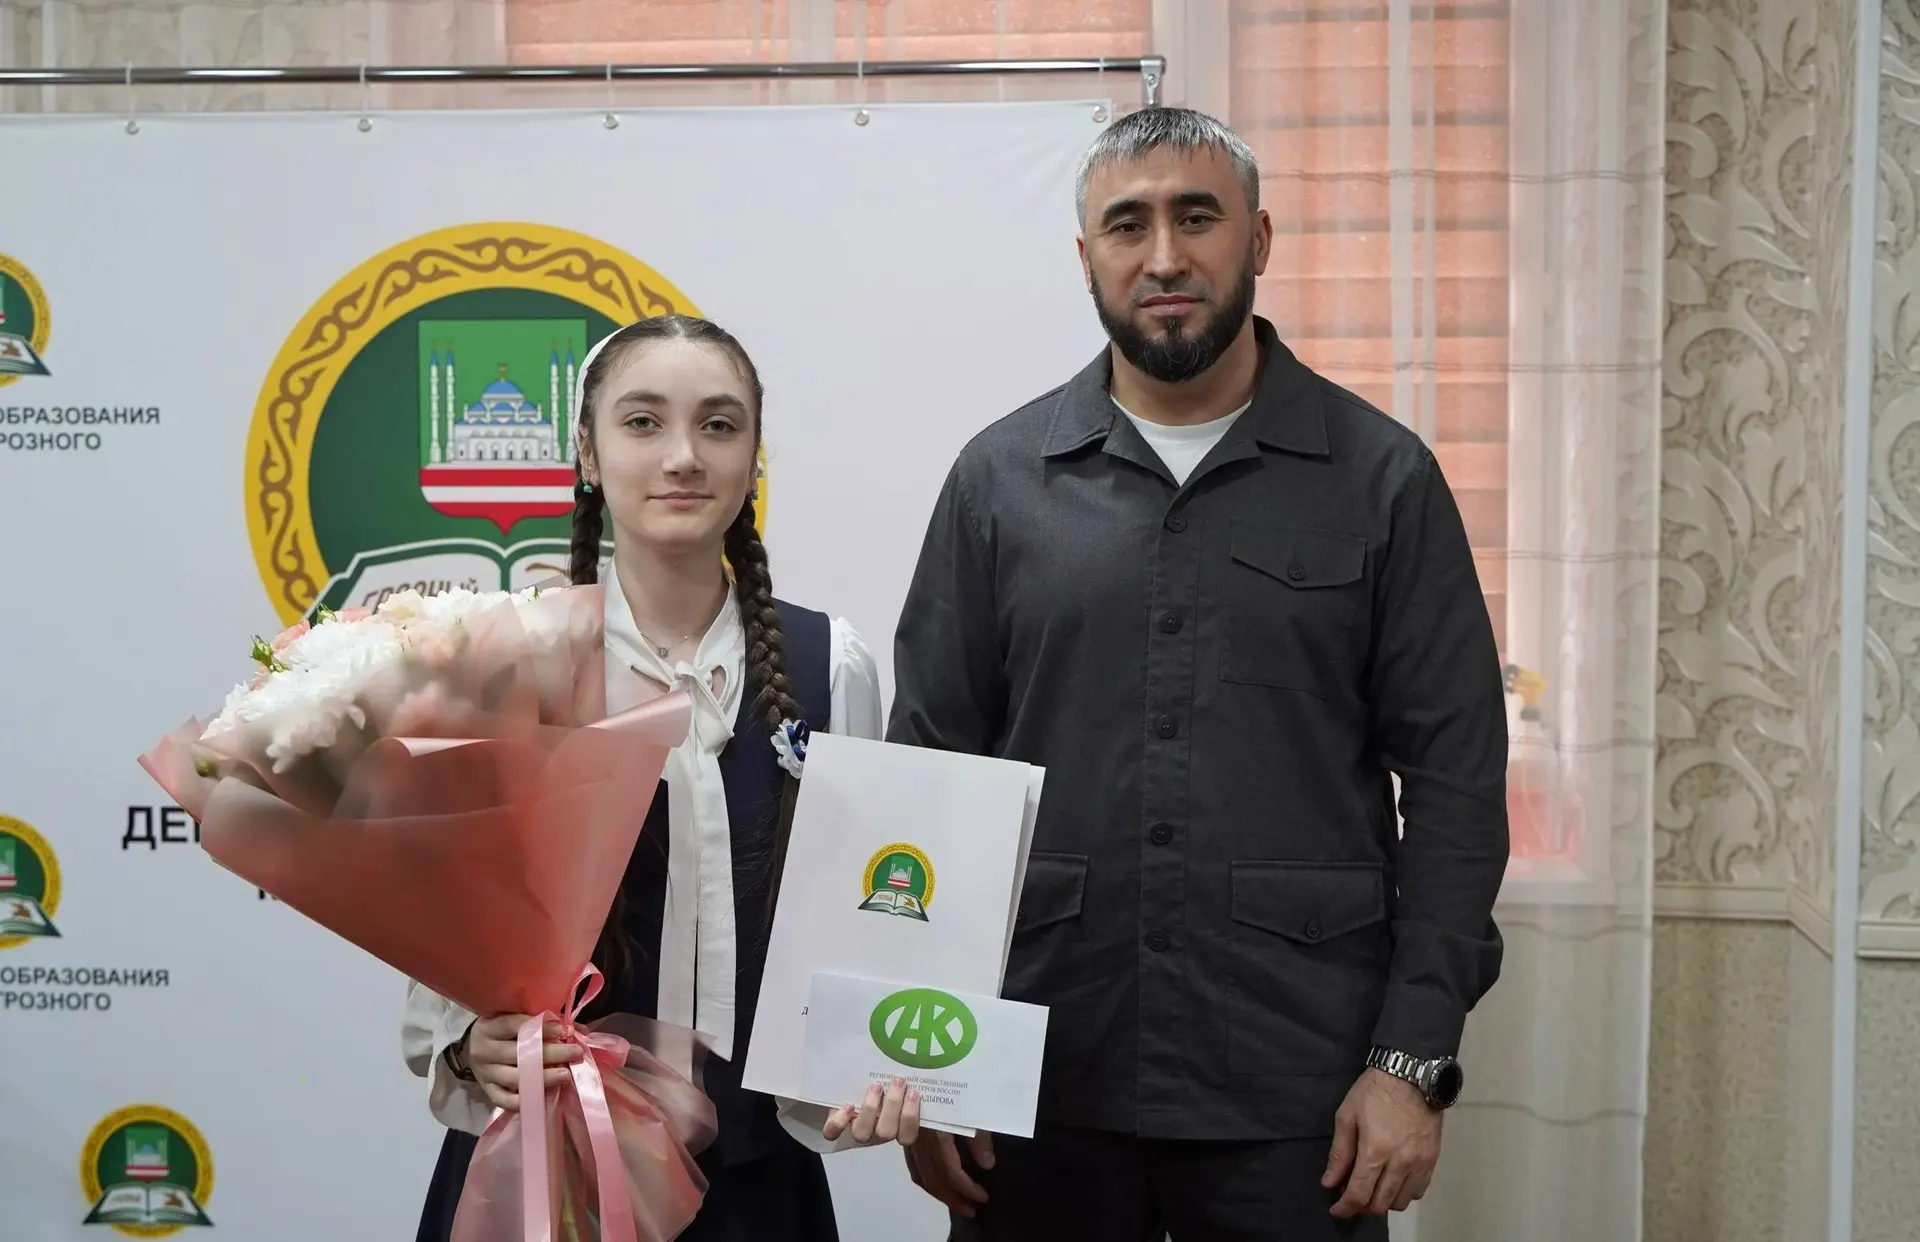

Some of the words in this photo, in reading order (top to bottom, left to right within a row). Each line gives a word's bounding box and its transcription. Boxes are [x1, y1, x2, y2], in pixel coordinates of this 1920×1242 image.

[0, 406, 160, 425] БРАЗОВАНИЯ
[0, 966, 169, 987] ОБРАЗОВАНИЯ
[920, 1094, 955, 1106] АДЫРОВА
